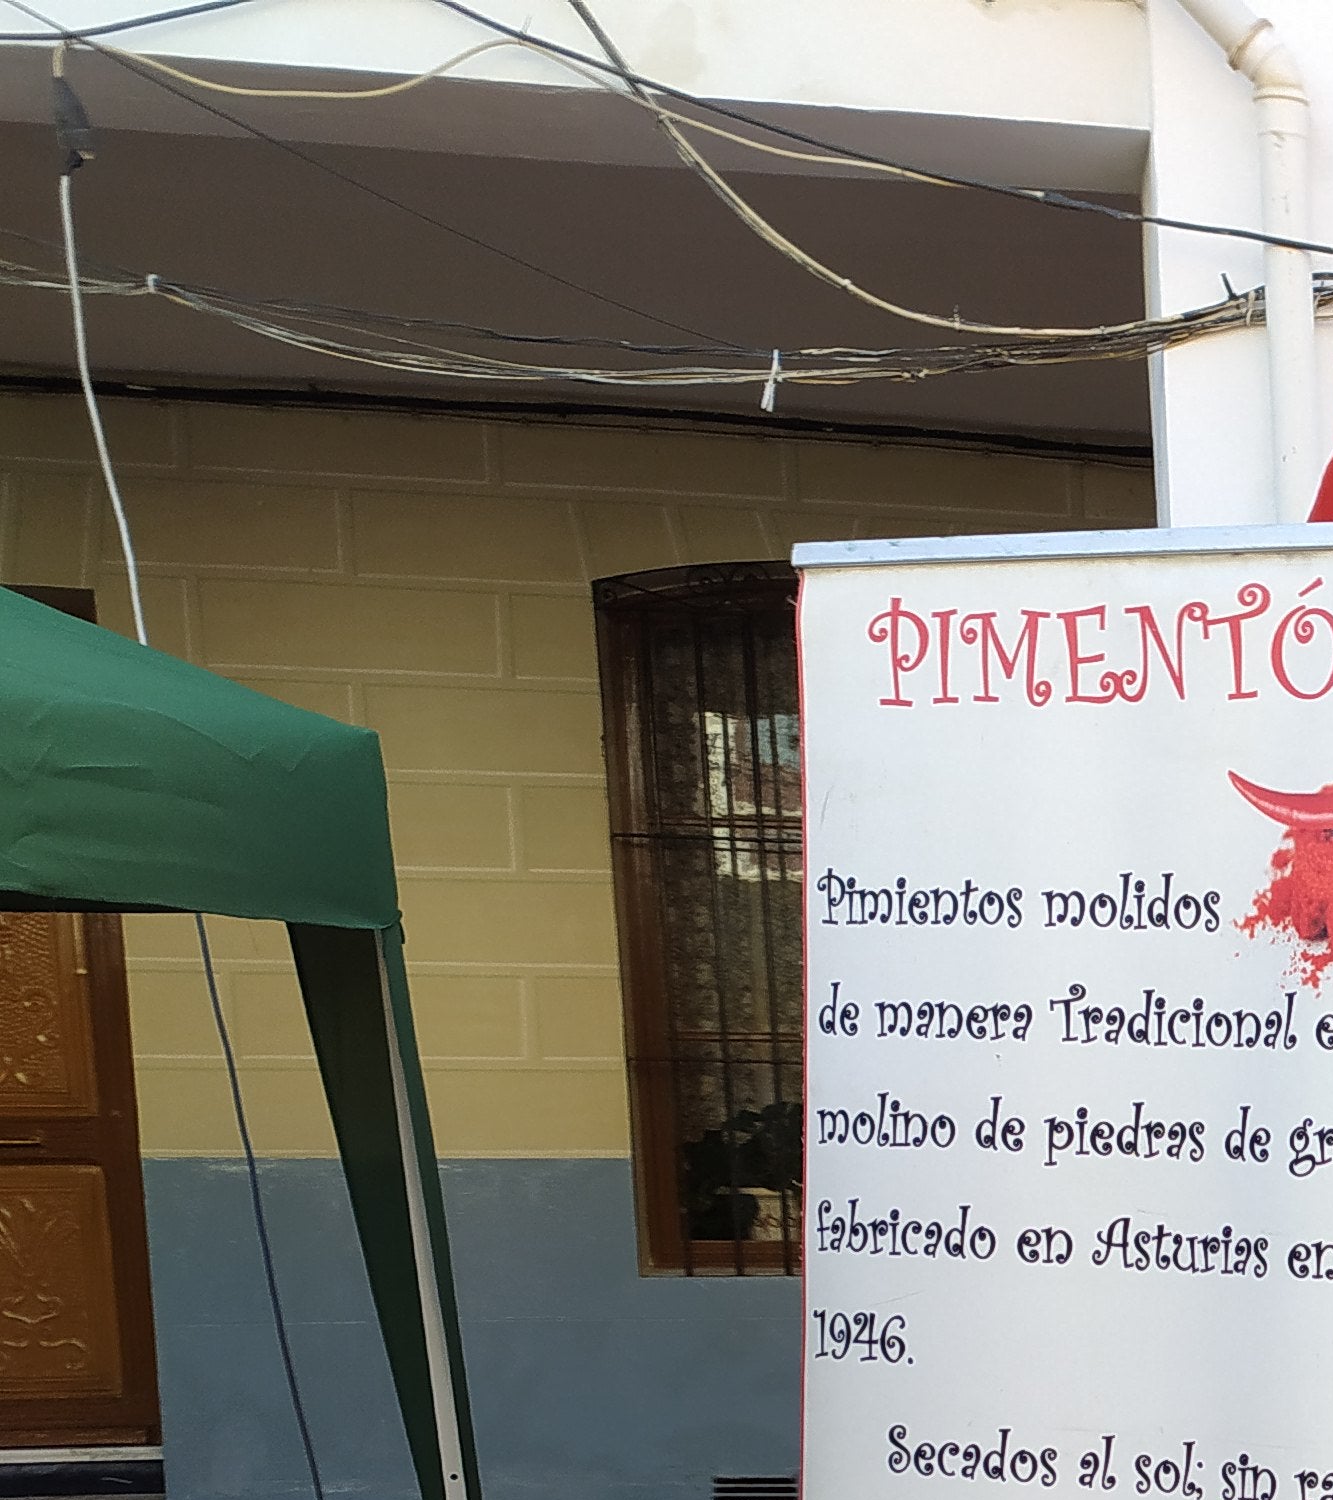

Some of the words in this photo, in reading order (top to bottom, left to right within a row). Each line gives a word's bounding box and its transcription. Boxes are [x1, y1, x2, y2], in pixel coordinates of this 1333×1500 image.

[817, 868, 1023, 929] Pimientos
[1041, 872, 1221, 933] molidos
[818, 981, 860, 1037] de
[874, 1001, 1033, 1041] manera
[1049, 983, 1297, 1050] Tradicional
[816, 1091, 956, 1148] molino
[975, 1096, 1026, 1152] de
[1044, 1102, 1205, 1166] piedras
[1224, 1105, 1271, 1163] de
[816, 1198, 996, 1260] fabricado
[1016, 1227, 1073, 1265] en
[1091, 1217, 1269, 1278] Asturias
[813, 1309, 914, 1365] 1946.
[888, 1424, 1058, 1487] Secados
[1078, 1435, 1116, 1490] al
